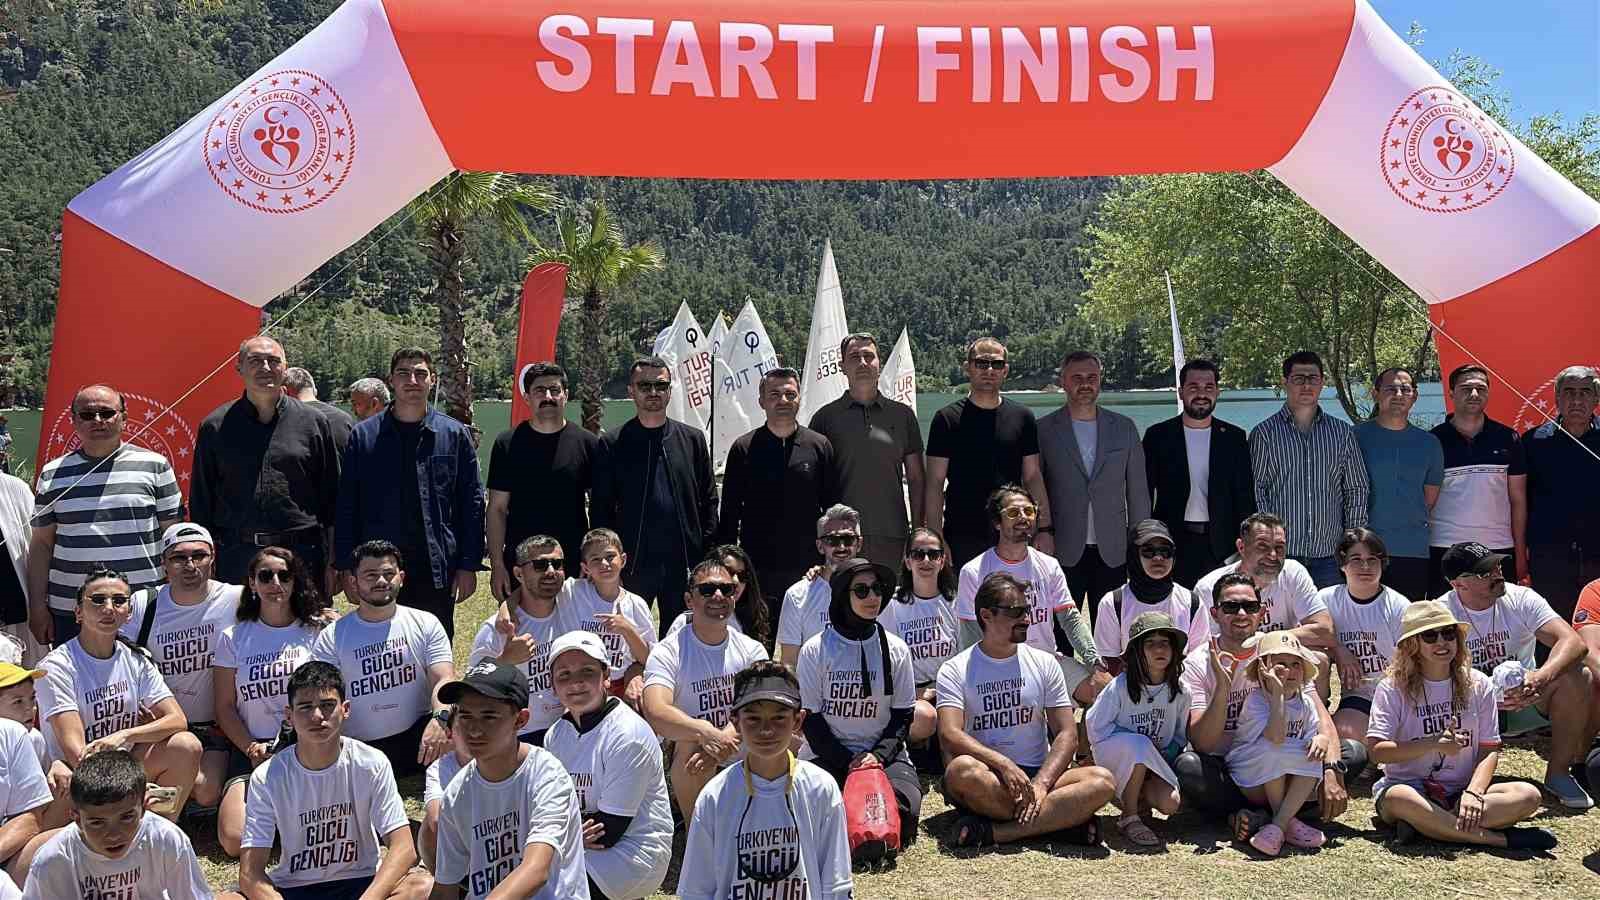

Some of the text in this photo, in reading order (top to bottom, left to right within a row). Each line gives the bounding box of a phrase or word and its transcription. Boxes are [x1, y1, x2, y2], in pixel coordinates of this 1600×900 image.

[535, 14, 834, 100] START
[916, 24, 1215, 103] FINISH
[683, 351, 711, 374] TUR
[905, 626, 941, 645] GÜCÜ
[163, 637, 208, 661] GÜCÜ
[249, 660, 295, 682] GÜCÜ
[361, 648, 404, 676] GÜCÜ
[983, 689, 1021, 712] GÜCÜ
[306, 818, 348, 847] GÜCÜ
